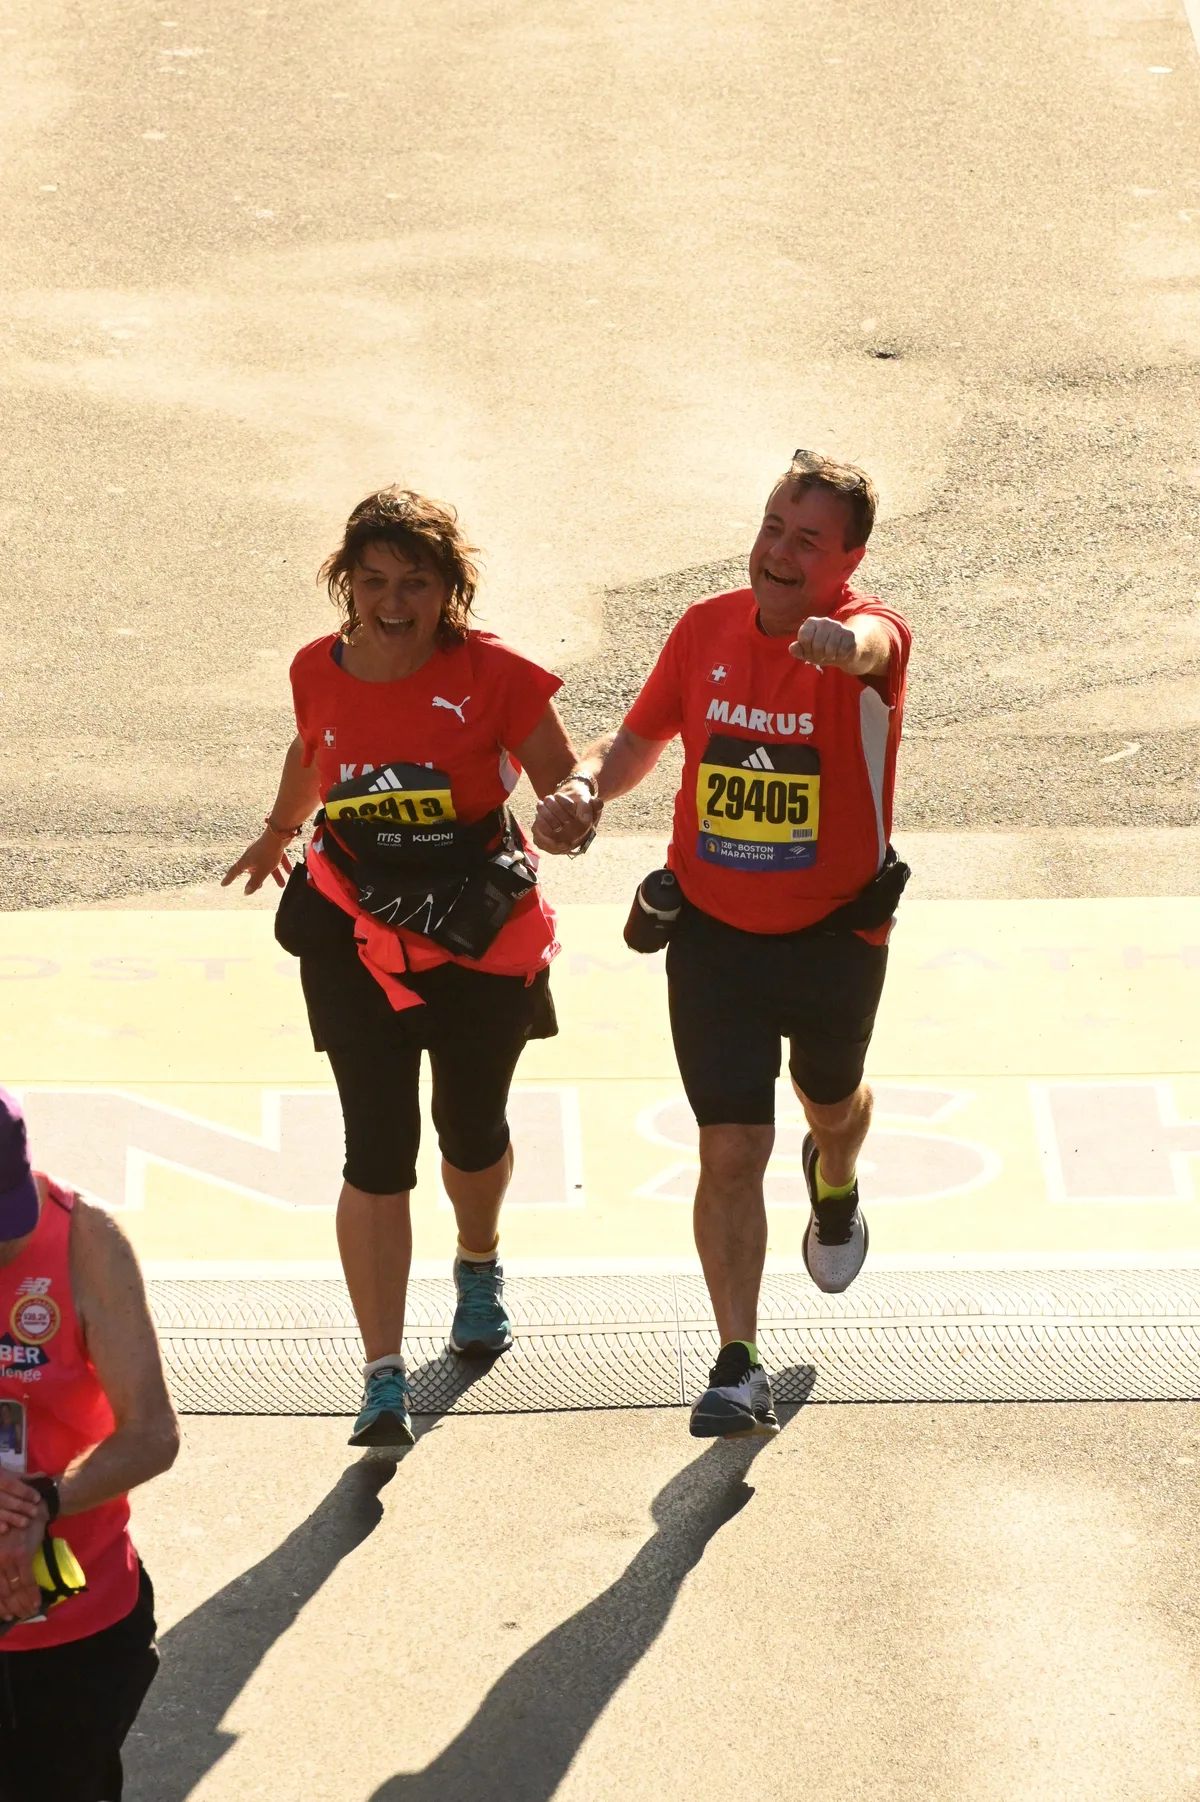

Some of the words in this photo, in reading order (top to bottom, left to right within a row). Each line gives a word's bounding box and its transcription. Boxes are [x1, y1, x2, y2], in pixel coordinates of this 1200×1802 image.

[706, 698, 815, 735] MARKUS
[706, 773, 809, 825] 29405
[703, 820, 710, 829] 6
[412, 832, 454, 843] KUONI
[720, 848, 774, 860] MARATHON
[738, 844, 774, 853] BOSTON
[0, 1344, 41, 1364] BER
